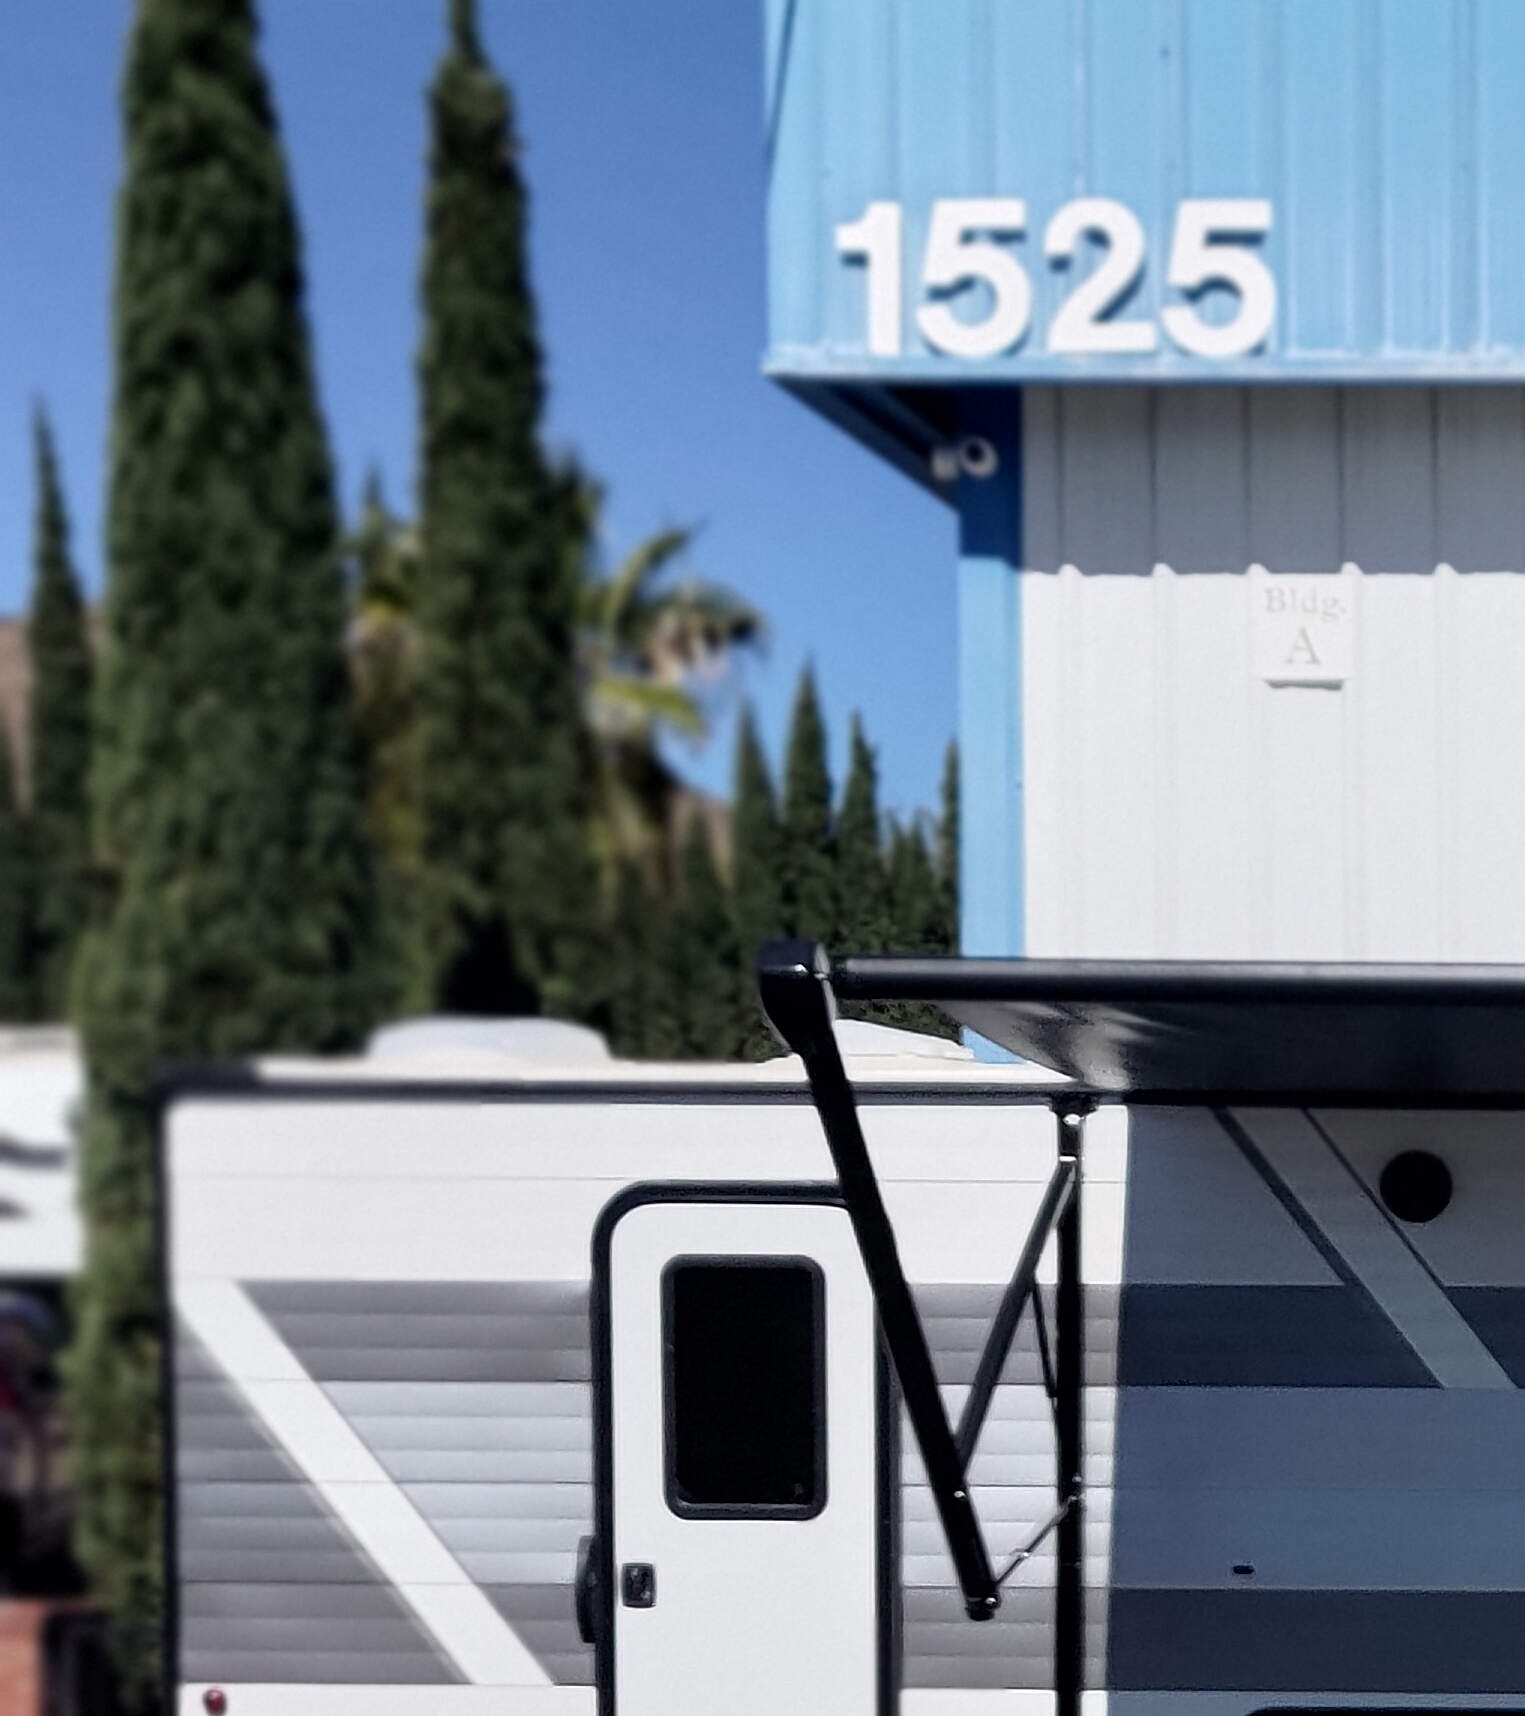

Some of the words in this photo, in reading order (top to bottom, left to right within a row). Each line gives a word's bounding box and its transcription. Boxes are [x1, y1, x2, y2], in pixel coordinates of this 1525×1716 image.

[836, 199, 1277, 356] 1525
[1265, 586, 1345, 621] Bldg.
[1285, 626, 1322, 664] A
